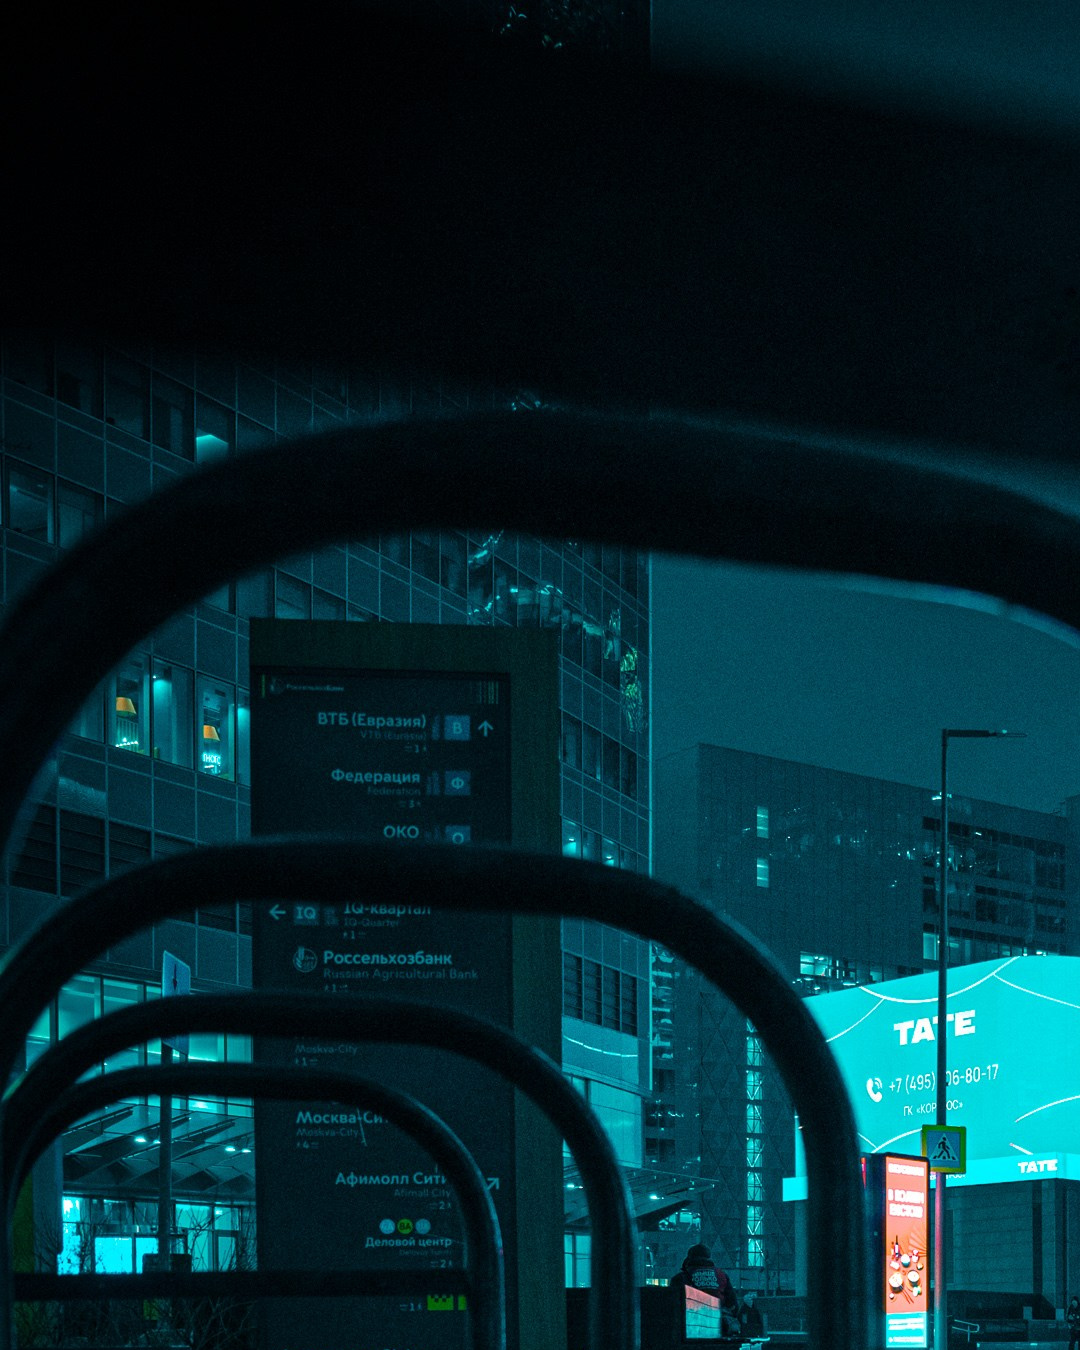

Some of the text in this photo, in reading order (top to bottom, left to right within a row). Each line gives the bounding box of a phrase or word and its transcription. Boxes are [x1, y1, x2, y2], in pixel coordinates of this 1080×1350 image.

[318, 711, 427, 729] ВТБ (Евразия)
[331, 768, 420, 784] Федерация
[383, 825, 420, 839] ОКО
[296, 906, 316, 919] IQ
[323, 950, 452, 965] Россельхозбанк
[323, 968, 479, 982] Russian Agricultural Bank
[295, 1044, 358, 1056] Moskva-City
[889, 1063, 999, 1095] +7 (495) 06-80-17
[903, 1099, 963, 1116] ГК «КОРОС»
[296, 1110, 388, 1124] Москва-Си
[1017, 1159, 1058, 1174] TATE
[335, 1171, 409, 1187] Афимолл
[365, 1237, 452, 1249] Деловой центр
